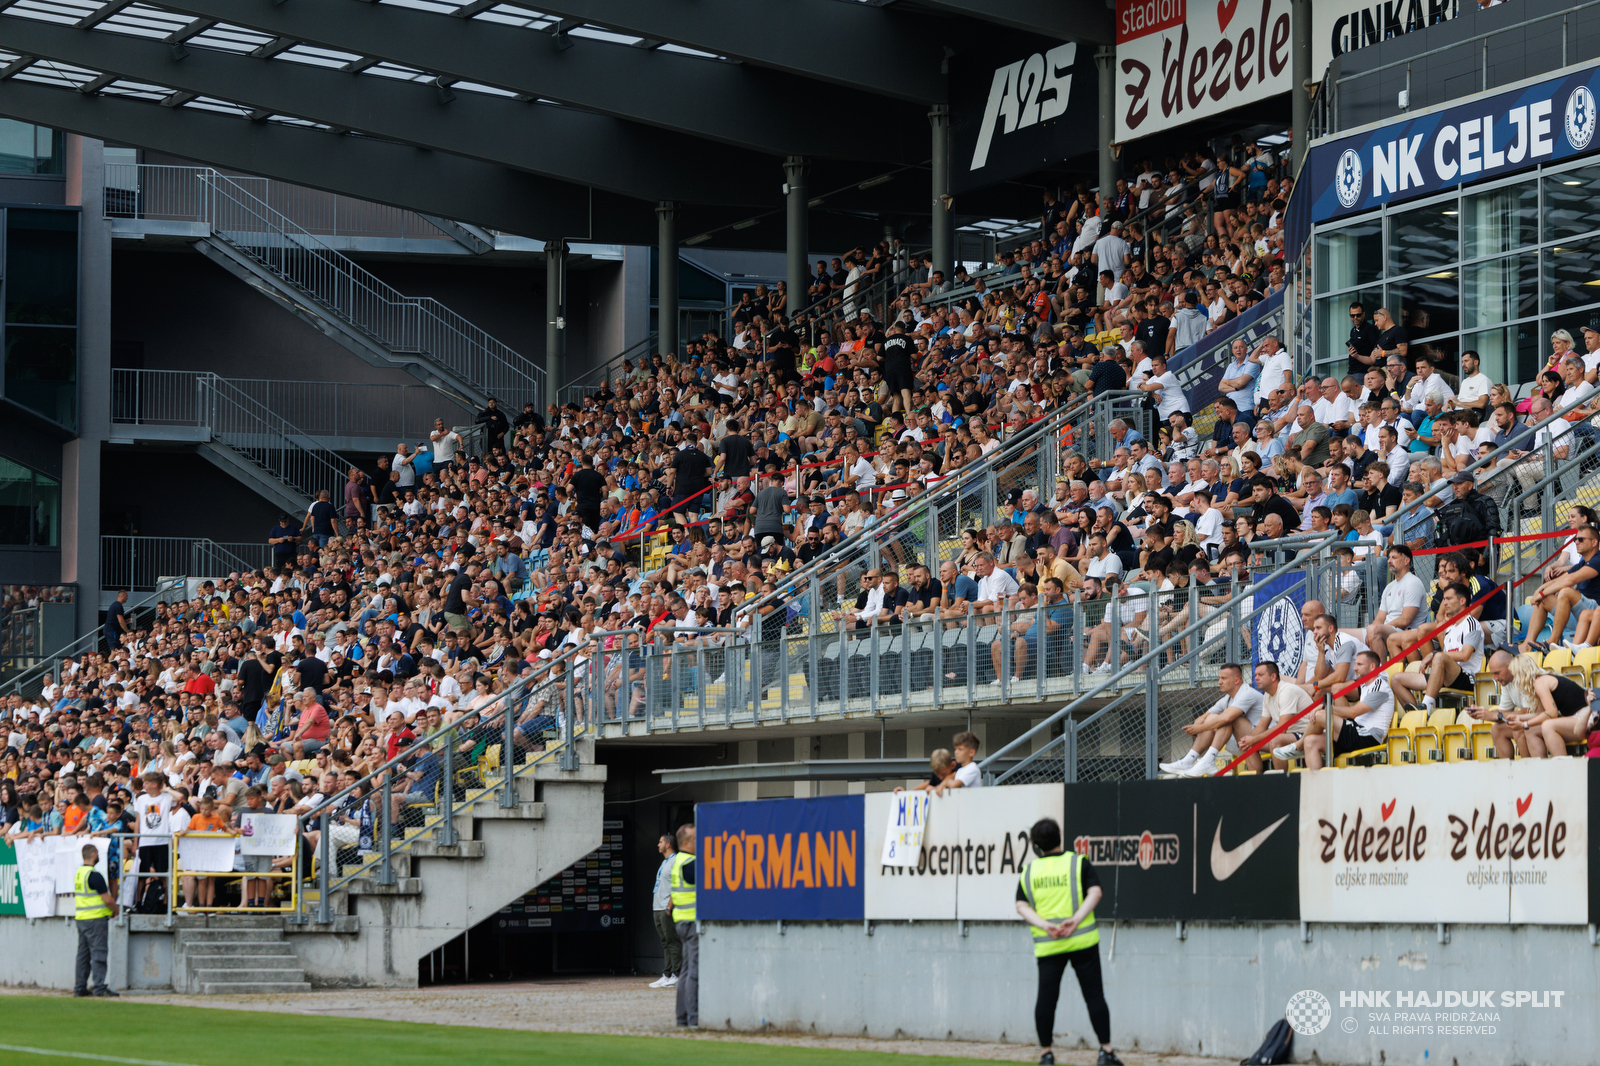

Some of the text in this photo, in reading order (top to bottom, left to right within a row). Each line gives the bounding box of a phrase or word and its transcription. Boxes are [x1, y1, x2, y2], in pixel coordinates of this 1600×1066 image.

[1121, 0, 1187, 34] stadion
[1371, 98, 1554, 198] NK CELJE
[884, 338, 906, 351] MONACO
[704, 829, 857, 892] HÖRMANN
[881, 835, 996, 876] ocenter
[1335, 867, 1409, 890] celjske mesnine
[1466, 866, 1548, 890] celjske mesnine
